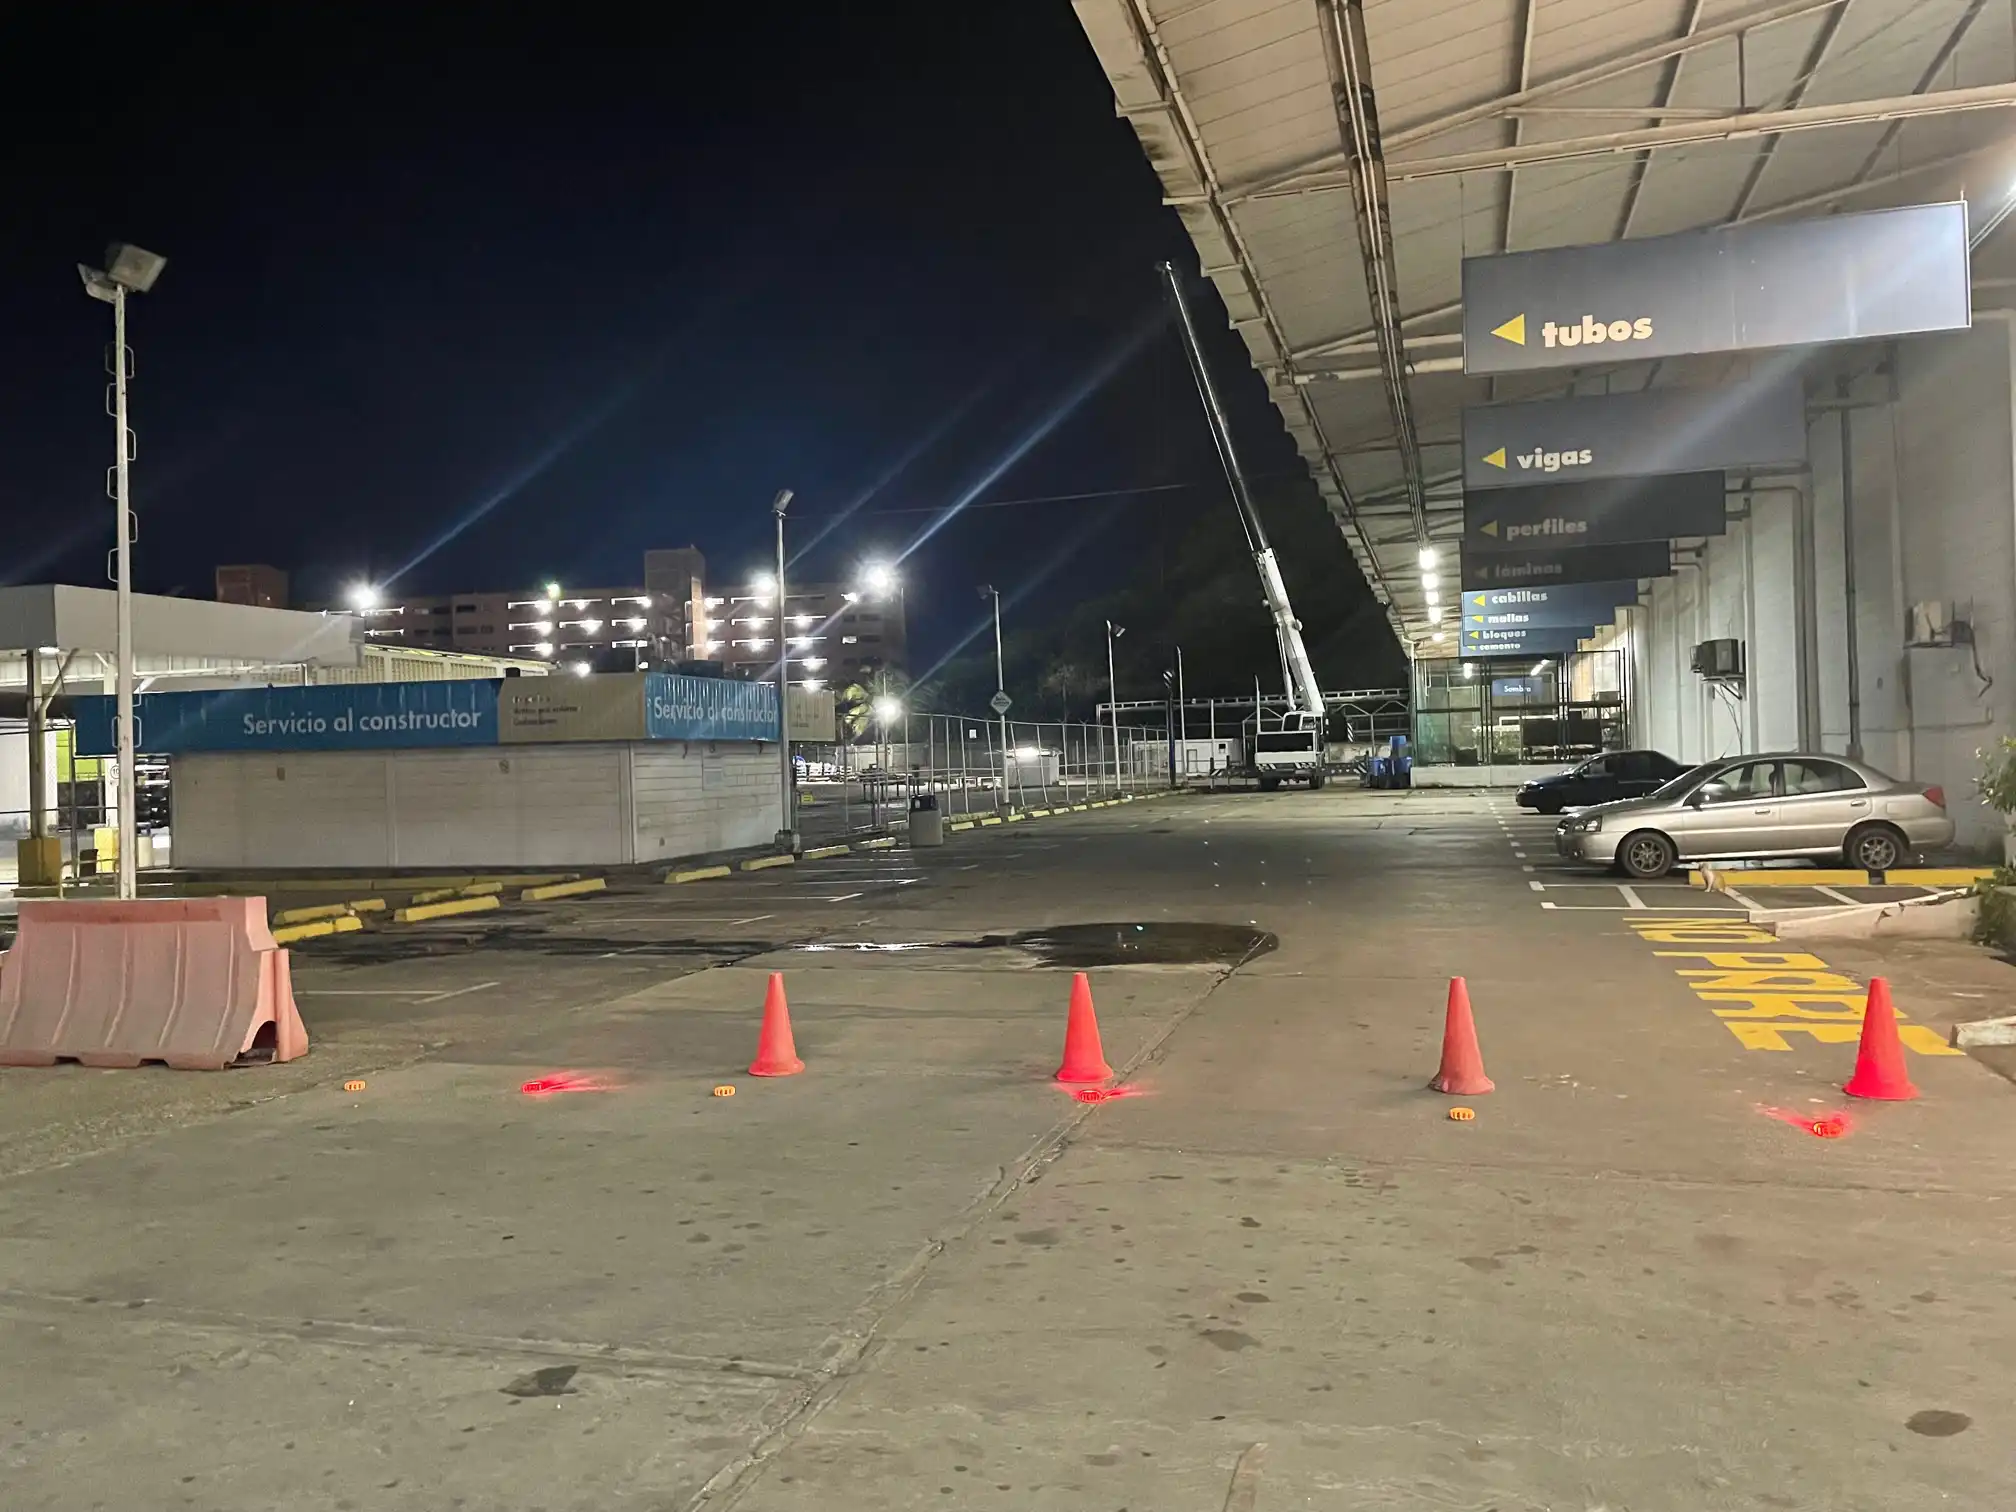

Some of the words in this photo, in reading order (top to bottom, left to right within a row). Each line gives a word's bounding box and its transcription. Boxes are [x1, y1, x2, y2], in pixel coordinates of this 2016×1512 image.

[1542, 315, 1653, 347] tubos
[1517, 447, 1593, 472] vigas
[1506, 518, 1587, 541] perfiles
[1492, 591, 1548, 604] cabillas
[1487, 613, 1530, 624] mallas
[1482, 630, 1527, 640] bloques
[654, 696, 704, 720] Servicio
[243, 713, 327, 735] Servicio
[333, 707, 353, 732] al
[359, 709, 482, 732] constructor
[1652, 951, 1967, 1056] PARE
